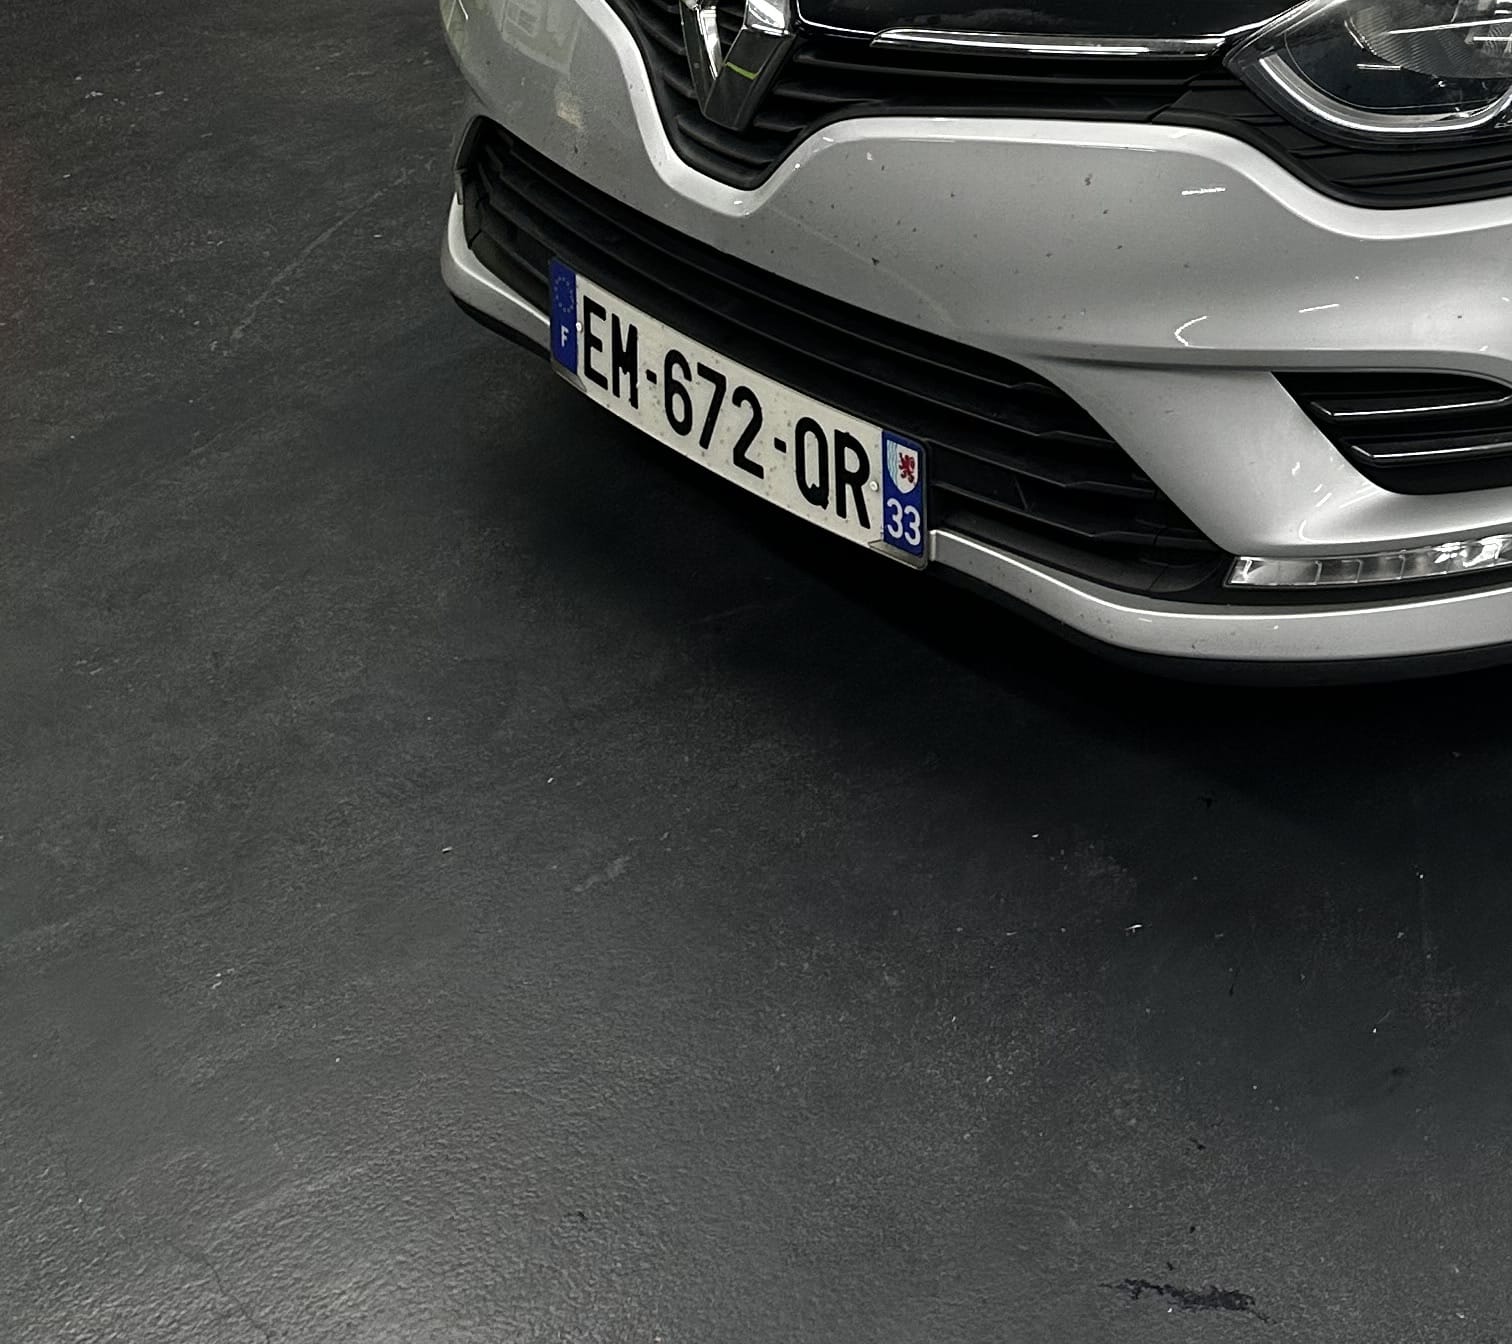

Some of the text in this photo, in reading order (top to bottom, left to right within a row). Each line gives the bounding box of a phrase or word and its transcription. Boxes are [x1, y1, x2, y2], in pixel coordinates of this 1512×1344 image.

[560, 325, 569, 348] F
[583, 295, 871, 529] EM-672-QR
[886, 498, 921, 546] 33
